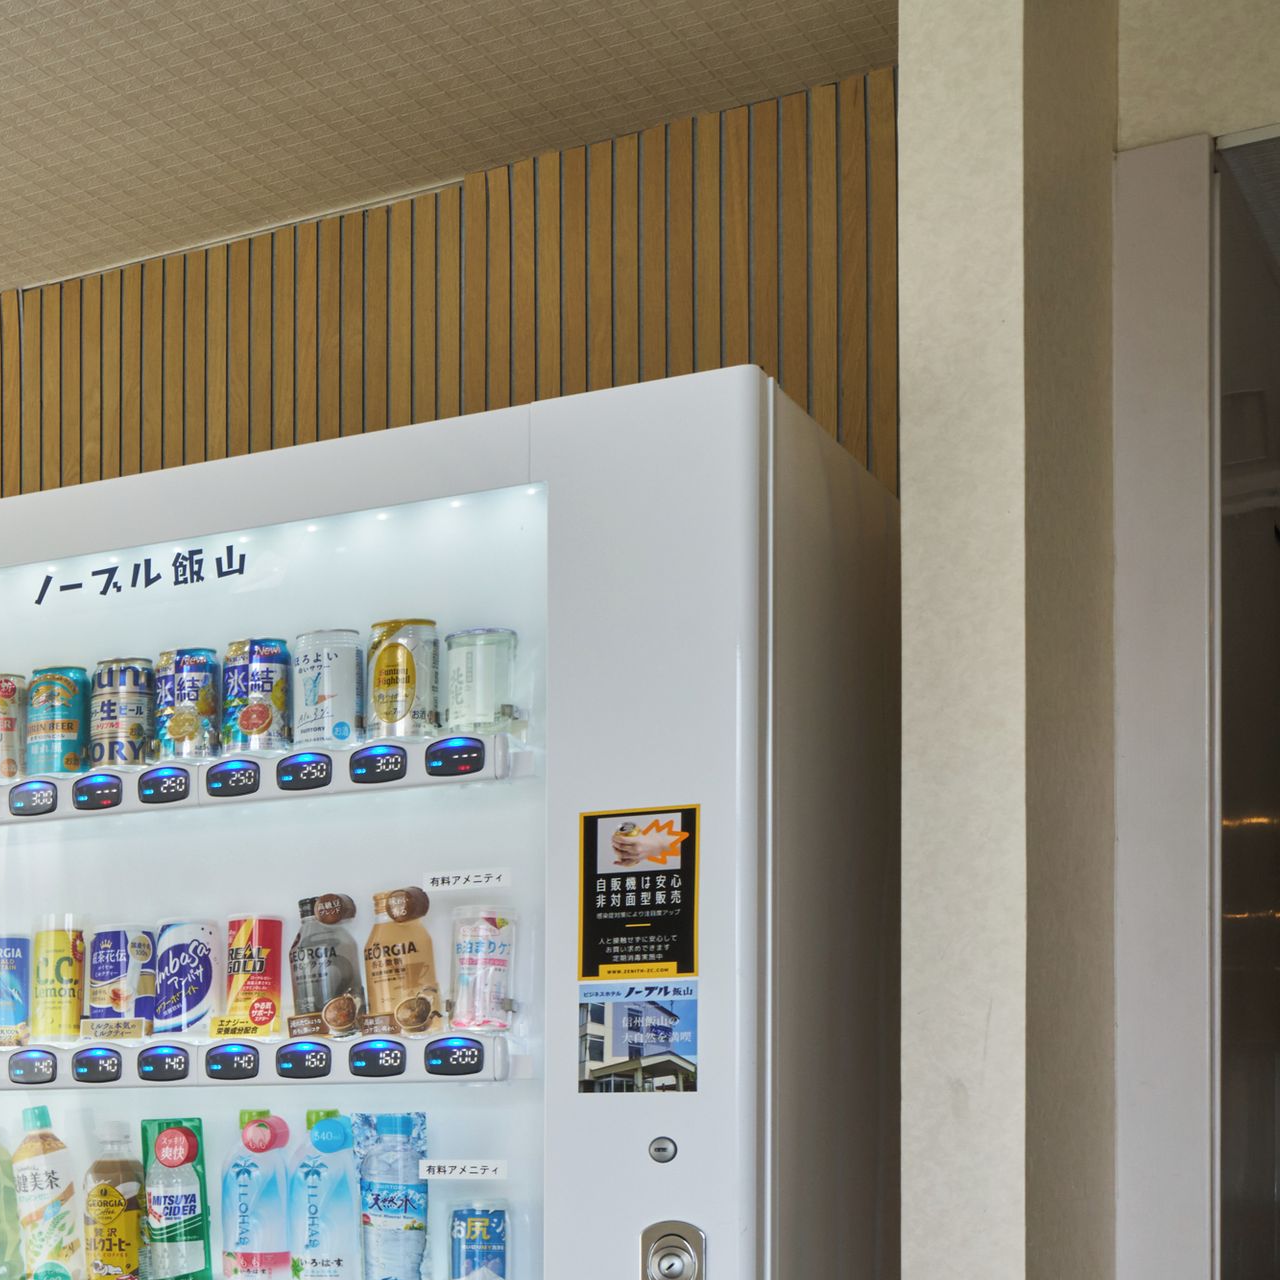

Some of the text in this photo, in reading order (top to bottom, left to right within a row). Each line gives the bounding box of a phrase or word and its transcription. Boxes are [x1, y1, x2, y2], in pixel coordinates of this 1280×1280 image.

[35, 545, 246, 605] ノーブル飯山
[227, 667, 274, 696] 氷結
[156, 676, 200, 706] 氷結
[48, 722, 74, 732] BEER
[375, 755, 402, 772] 300
[229, 770, 254, 786] 250
[300, 762, 327, 780] 250
[160, 777, 185, 793] 250
[32, 790, 53, 807] 300
[430, 873, 503, 886] 有料アメニティ
[596, 874, 682, 892] 自販機は安心
[596, 890, 681, 908] 非対面型販売
[599, 934, 678, 945] 人と接触せずに安心して
[228, 944, 265, 960] REAL
[165, 1057, 184, 1070] 140
[234, 1055, 254, 1068] 140
[305, 1053, 325, 1067] 160
[379, 1051, 400, 1065] 160
[450, 1049, 478, 1064] 200
[34, 1060, 53, 1074] 140
[98, 1058, 117, 1072] 140
[426, 1165, 499, 1175] 有料アメニティ
[152, 1194, 196, 1206] MITSUYA
[163, 1205, 196, 1216] CIDER
